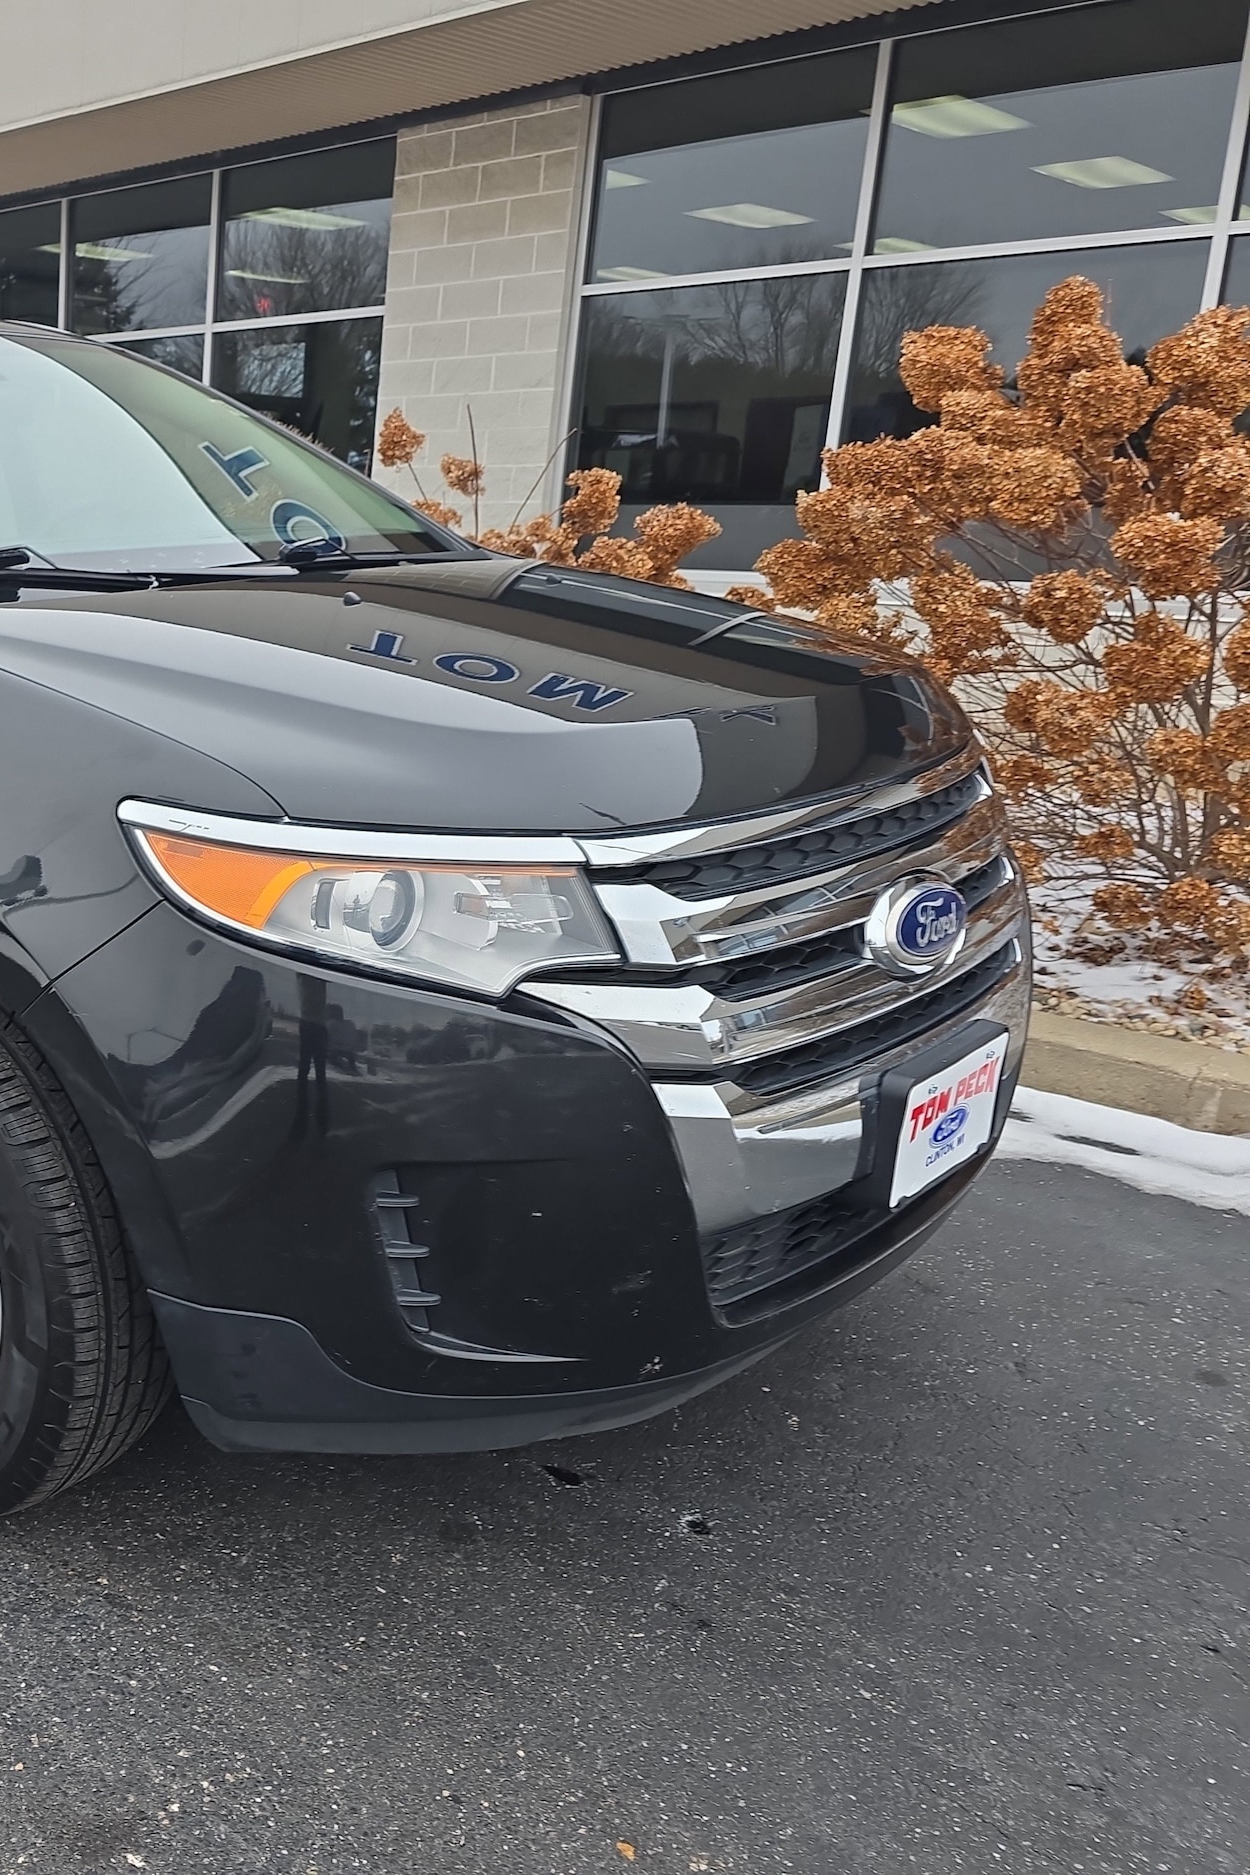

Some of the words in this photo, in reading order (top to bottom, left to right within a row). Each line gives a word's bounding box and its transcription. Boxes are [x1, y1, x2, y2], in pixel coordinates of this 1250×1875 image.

[916, 897, 957, 948] Ford
[910, 1086, 952, 1143] TOM
[954, 1055, 1000, 1106] PECK
